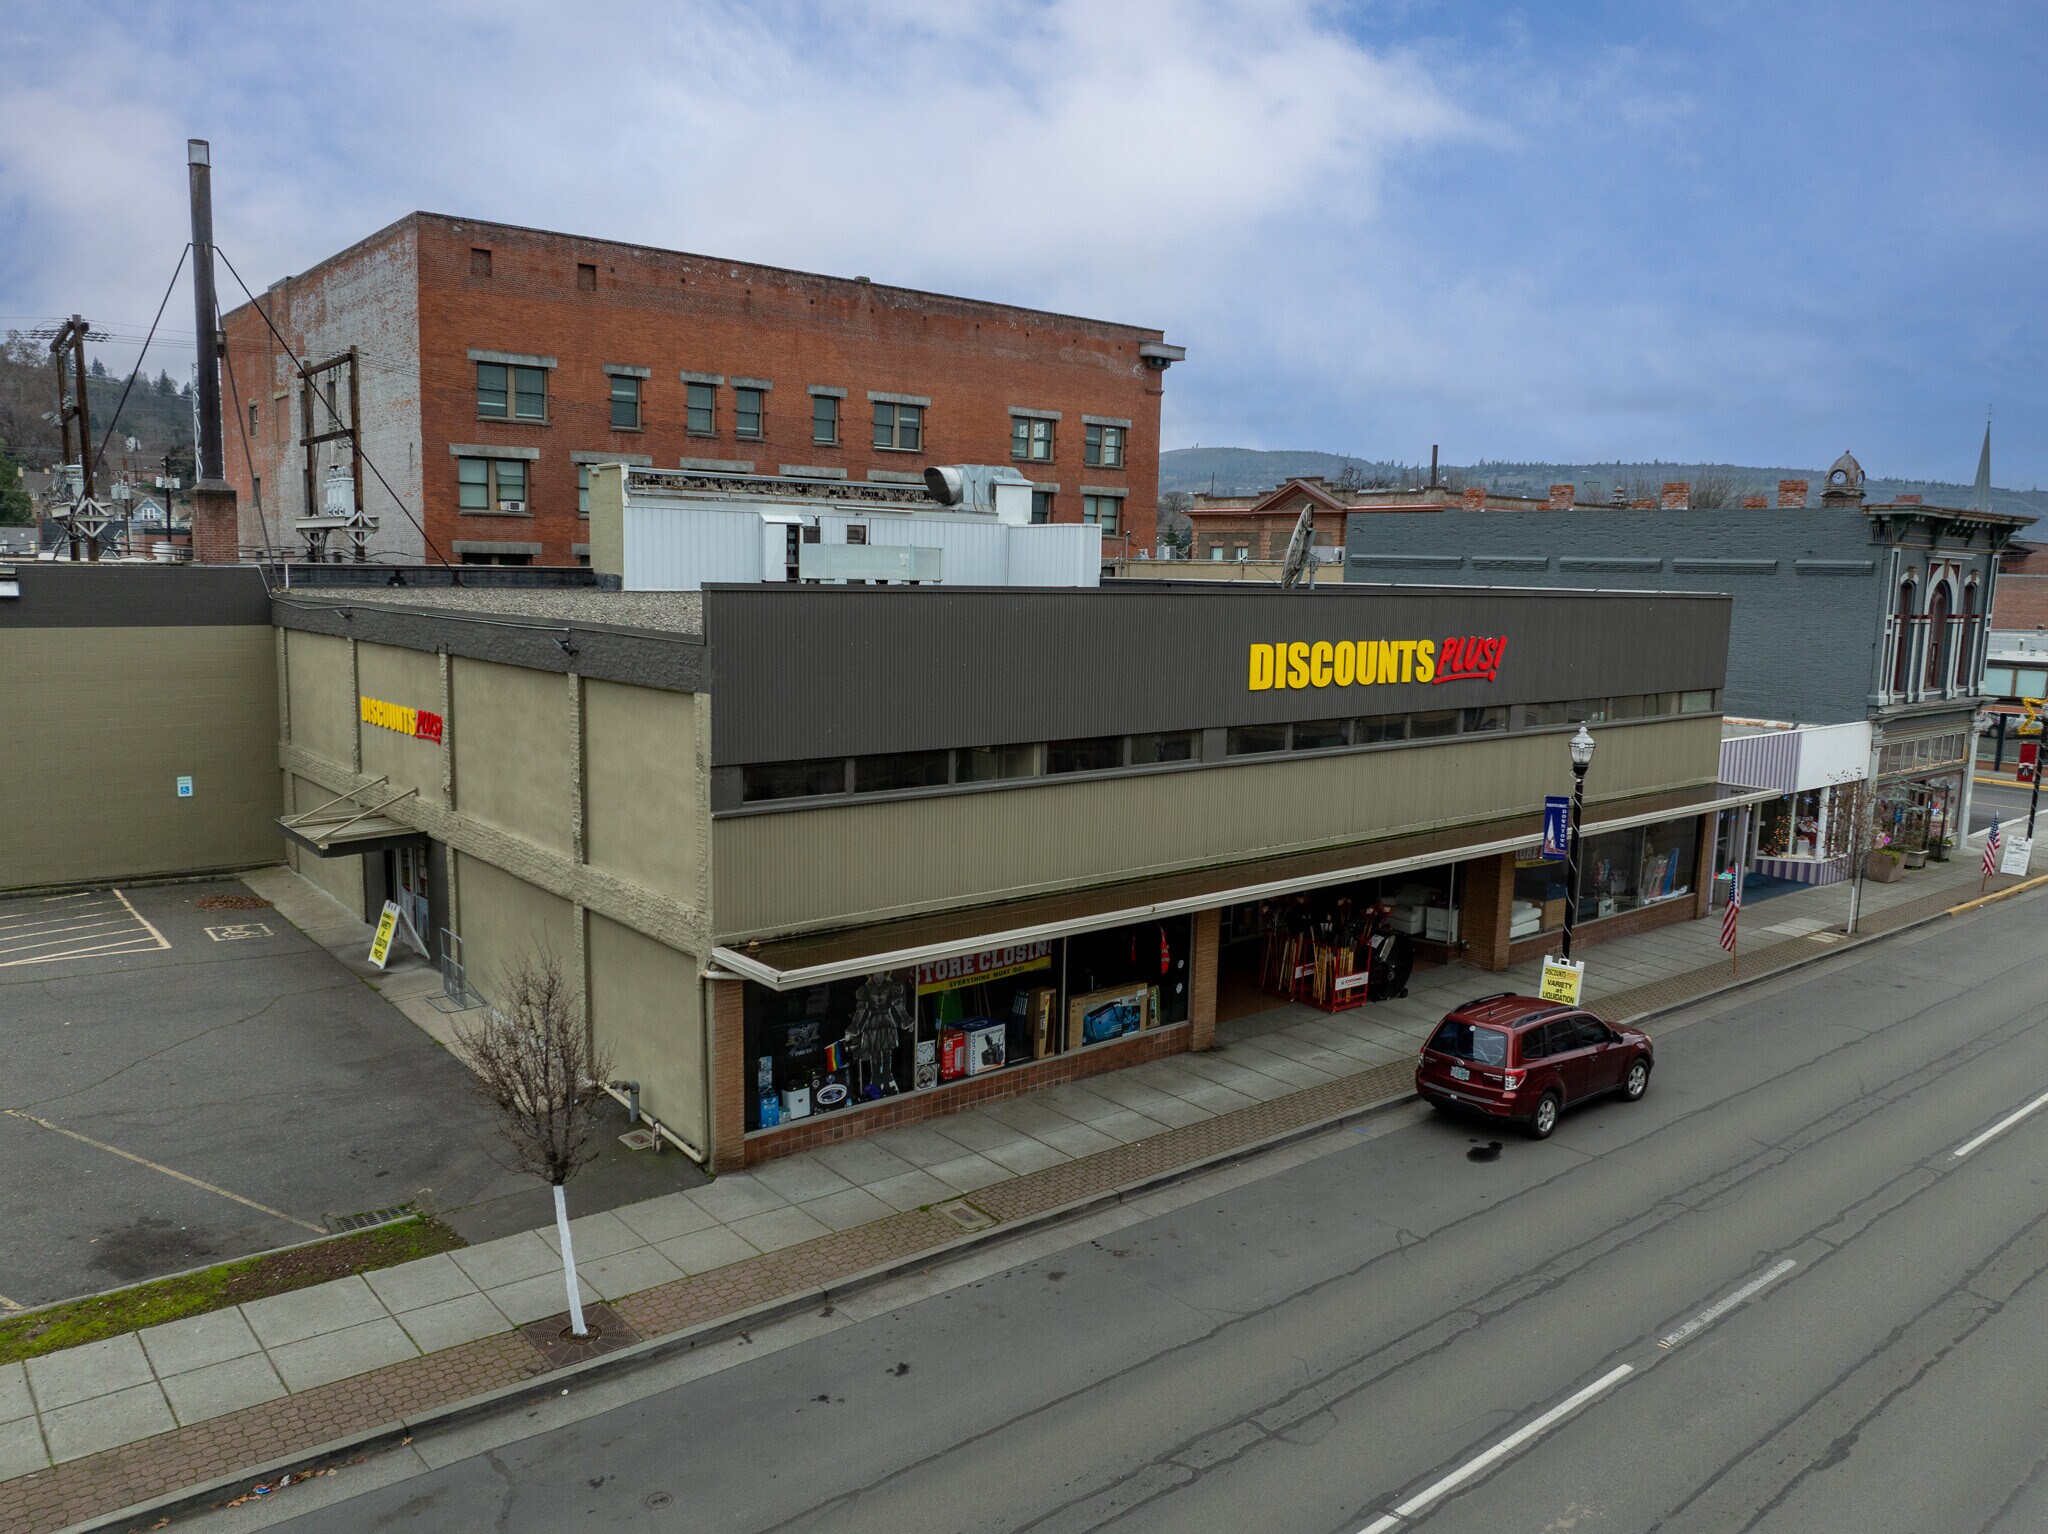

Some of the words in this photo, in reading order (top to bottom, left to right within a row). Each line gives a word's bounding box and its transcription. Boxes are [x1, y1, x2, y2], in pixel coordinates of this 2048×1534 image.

[1249, 639, 1435, 691] DISCOUNTS
[1433, 635, 1507, 684] PLUS!
[360, 696, 416, 737] DISCOUNTS
[1559, 809, 1567, 848] DOWNTOWN
[949, 973, 990, 987] EVERYTHING
[993, 969, 1010, 979] MUST
[1545, 967, 1567, 978] DISCOUNTS
[1547, 979, 1573, 989] VARIETY
[1542, 990, 1575, 1004] LIQUIDATION
